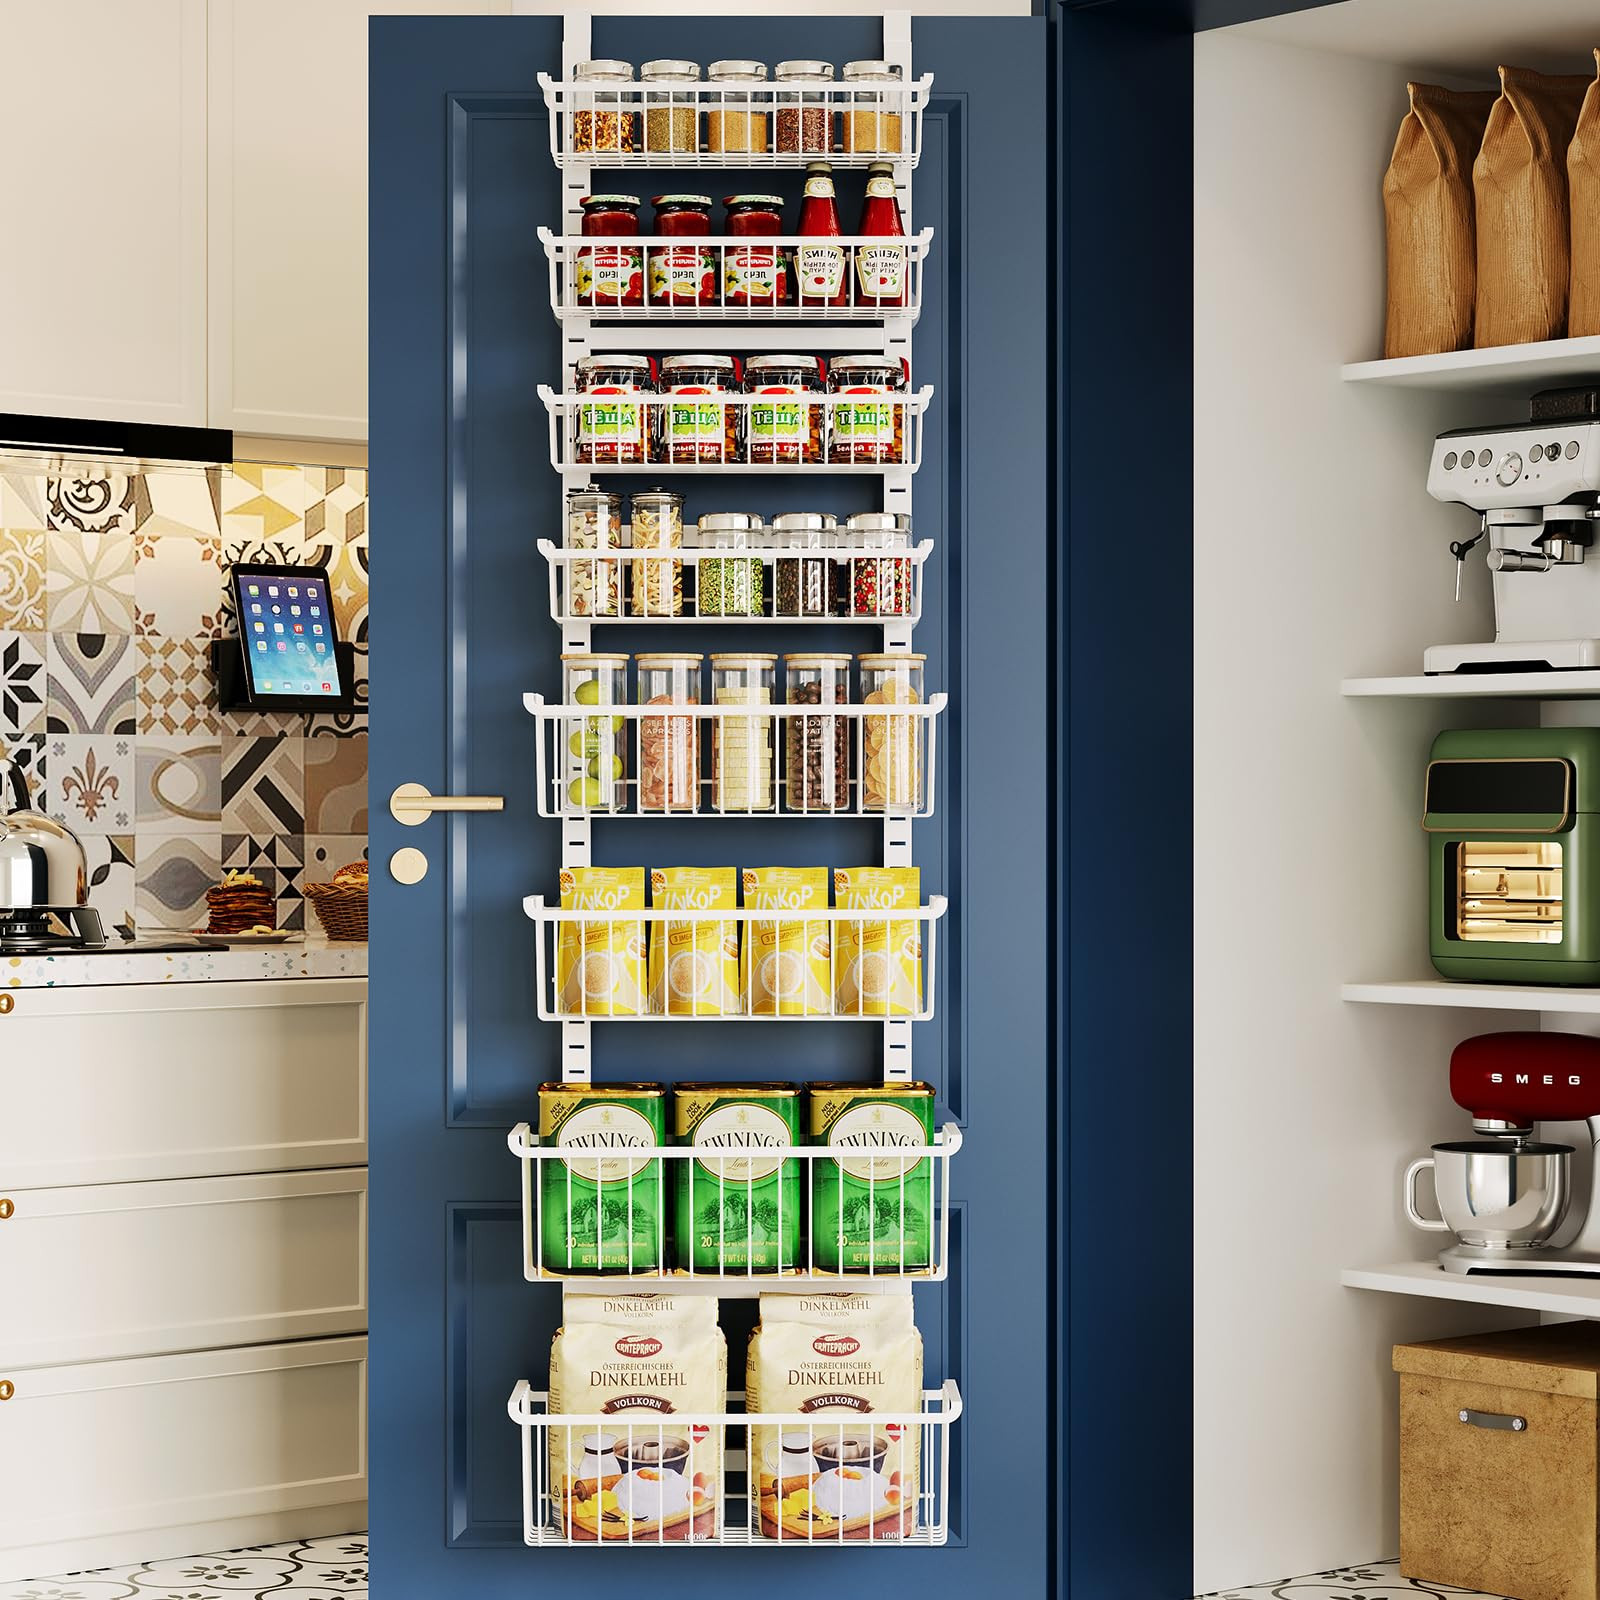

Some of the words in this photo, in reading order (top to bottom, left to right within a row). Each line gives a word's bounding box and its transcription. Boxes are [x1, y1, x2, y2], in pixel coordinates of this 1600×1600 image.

[1490, 1073, 1581, 1085] SMEG
[550, 1100, 561, 1114] NEW
[552, 1105, 566, 1119] LOOK
[686, 1100, 698, 1113] NEW
[688, 1104, 702, 1119] LOOK
[821, 1100, 833, 1113] NEW
[824, 1104, 838, 1118] LOOK
[701, 1236, 713, 1248] 20
[604, 1302, 675, 1312] DINKELMEHL
[800, 1301, 871, 1311] DINKELMEHL
[616, 1343, 661, 1355] ERNTEPRACHT
[813, 1342, 859, 1354] ERNTEPRACHT
[602, 1362, 674, 1371] ÖSTERREICHISCHES
[800, 1361, 872, 1370] ÖSTERREICHISCHES
[590, 1371, 687, 1387] DINKELMEHL
[788, 1370, 885, 1386] DINKELMEHL
[613, 1398, 662, 1409] VOLLKORN
[812, 1396, 861, 1408] VOLLKORN
